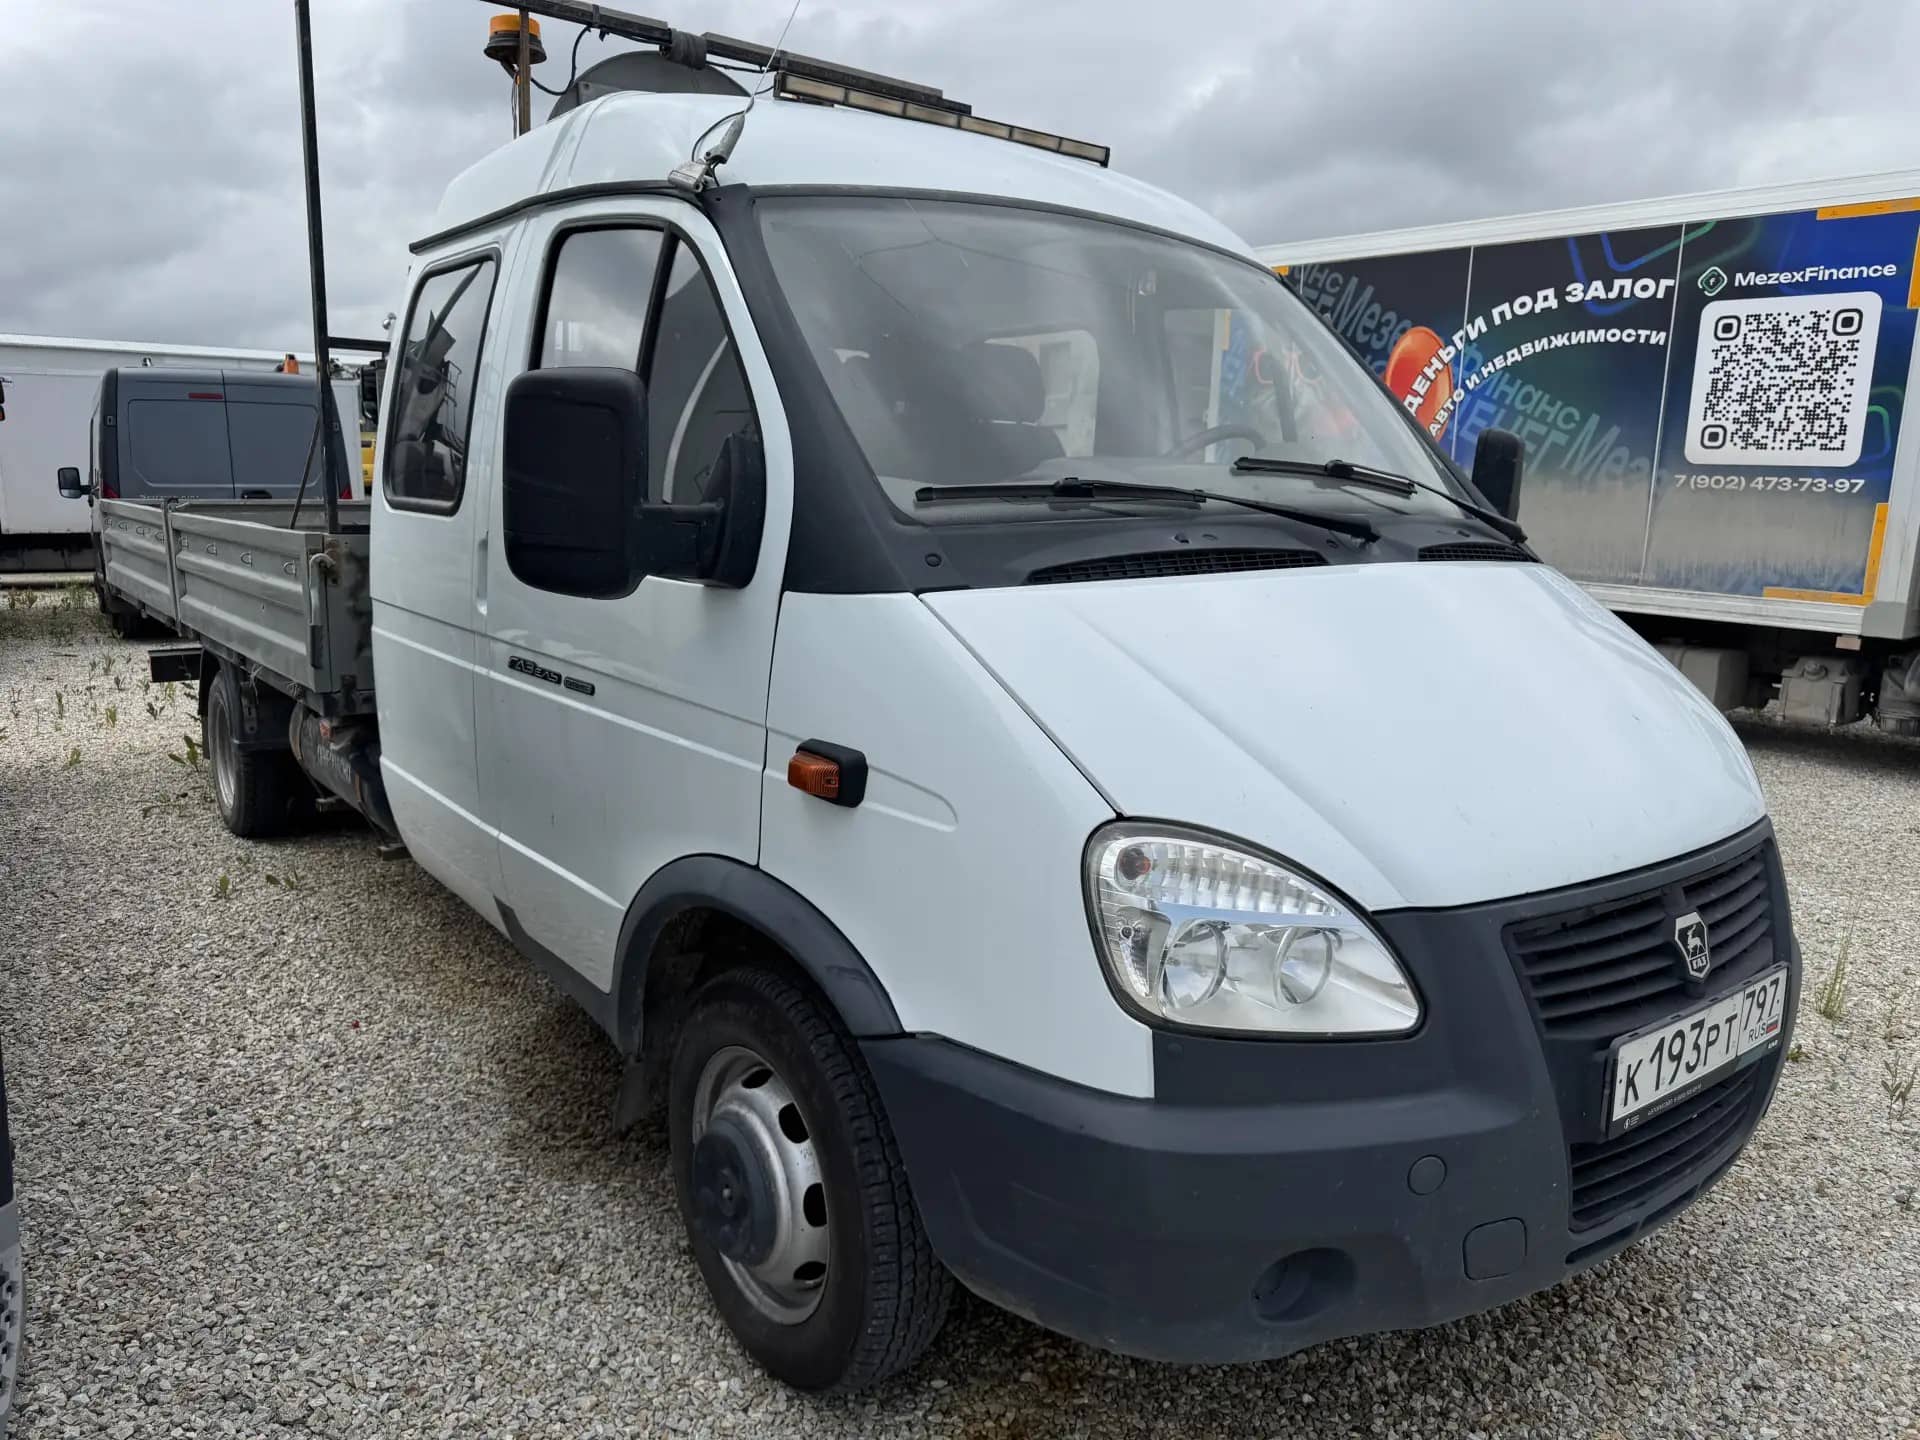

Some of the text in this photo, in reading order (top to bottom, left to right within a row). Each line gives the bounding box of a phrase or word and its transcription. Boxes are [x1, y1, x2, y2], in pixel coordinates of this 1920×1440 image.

[1733, 263, 1897, 288] MezexFinance
[1403, 315, 1488, 417] ДЕНЬГИ
[1490, 287, 1558, 326] ПОД
[1564, 278, 1676, 303] ЗАЛОГ
[1428, 327, 1668, 438] АВТО И НЕДВИЖИМОСТИ
[1749, 476, 1865, 494] 473-73-97
[1743, 976, 1780, 1031] 797
[1748, 1021, 1767, 1042] RUS
